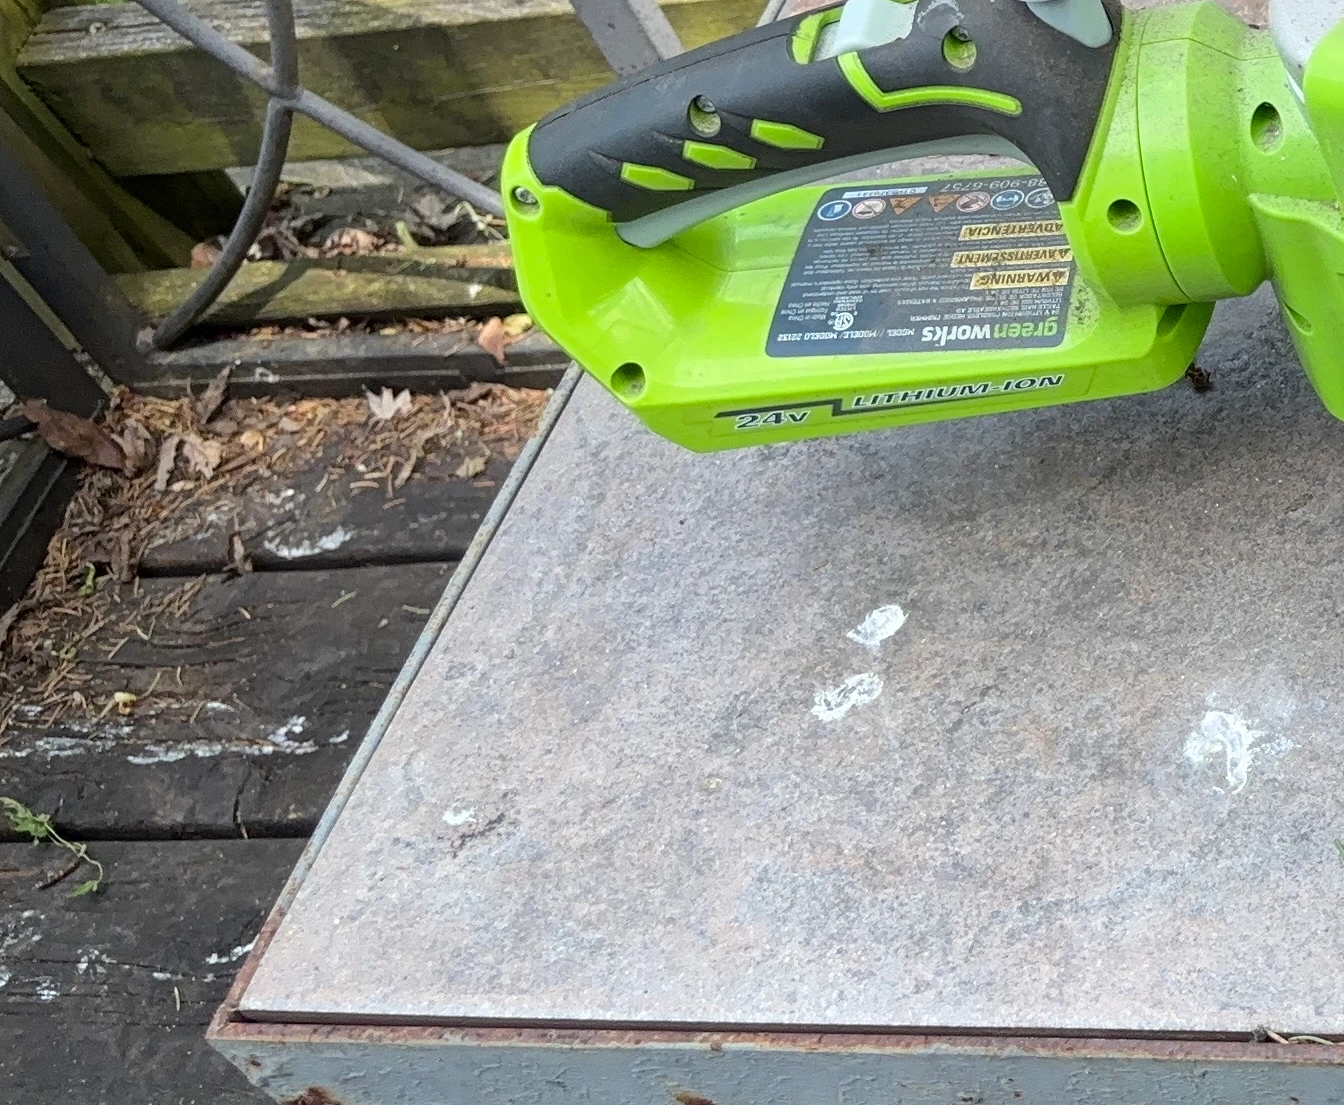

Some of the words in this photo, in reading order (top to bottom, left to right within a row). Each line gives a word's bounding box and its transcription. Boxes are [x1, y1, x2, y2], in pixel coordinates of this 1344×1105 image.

[802, 331, 838, 340] MODELO
[885, 328, 915, 336] MODEL
[919, 320, 1058, 345] greenworks
[851, 374, 1065, 408] LITHIUM-ION
